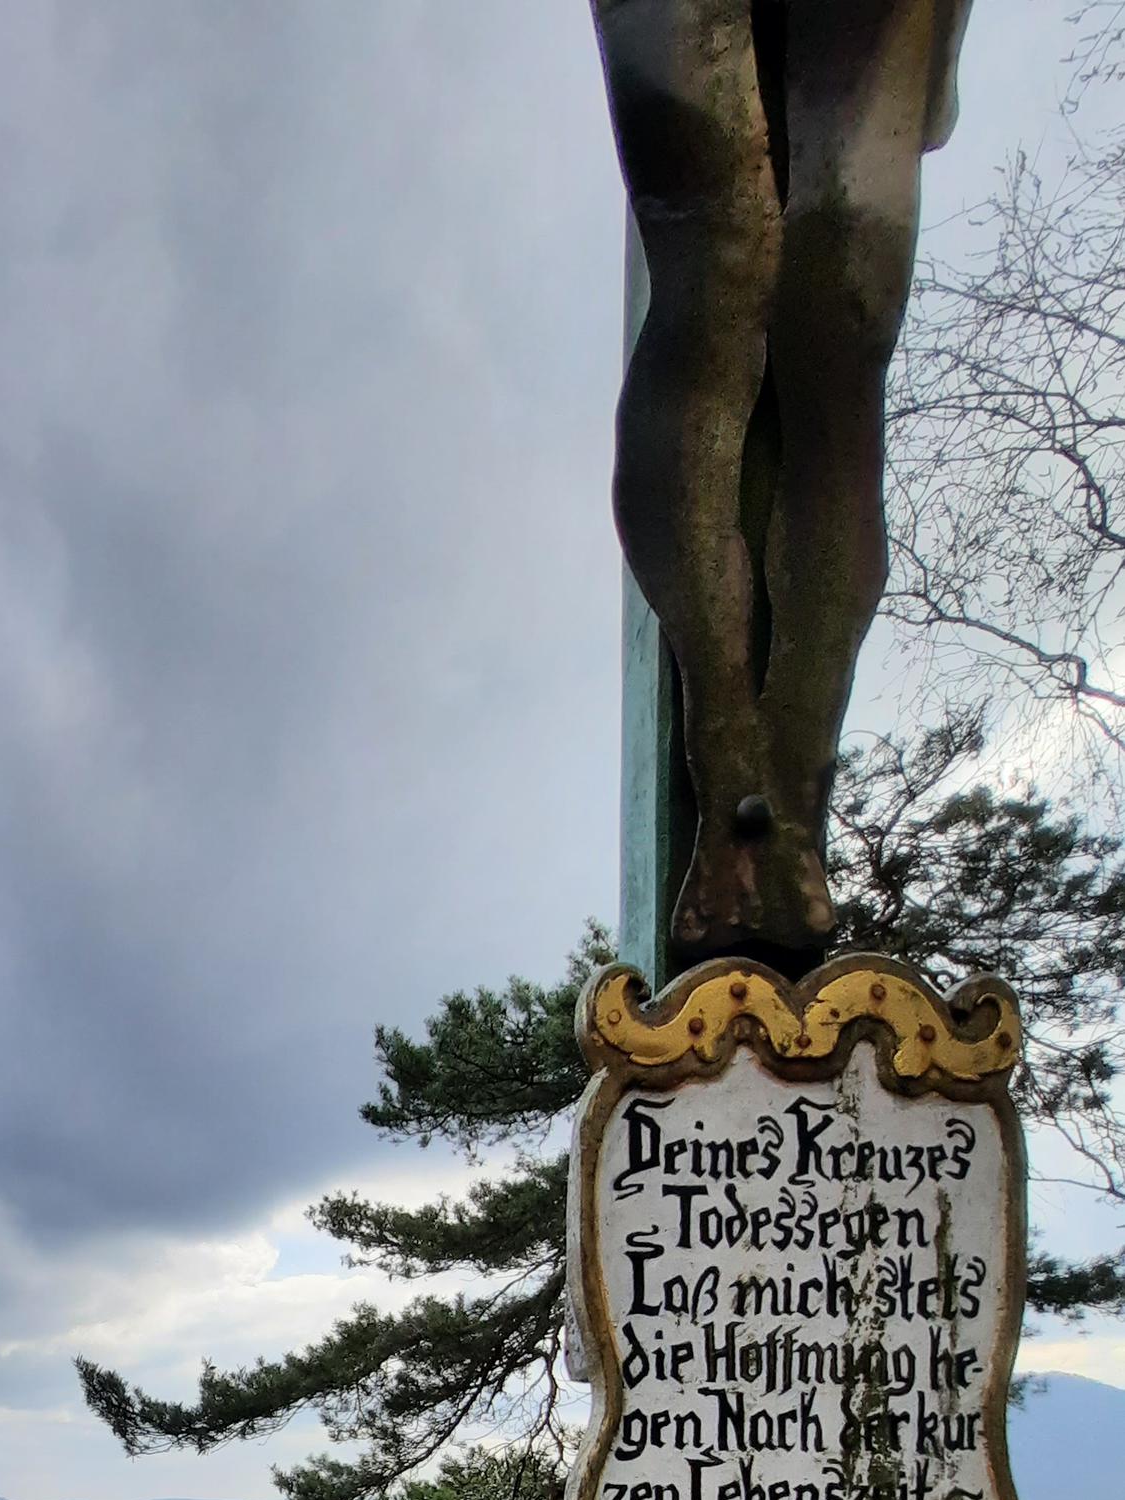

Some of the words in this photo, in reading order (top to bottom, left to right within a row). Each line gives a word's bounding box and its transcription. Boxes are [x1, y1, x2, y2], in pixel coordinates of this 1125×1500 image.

[613, 1096, 785, 1200] Deines
[785, 1096, 975, 1196] Kreuzes
[662, 1183, 930, 1259] Todessegen
[729, 1253, 856, 1319] mich
[875, 1253, 986, 1320] stets
[622, 1322, 694, 1390] die
[702, 1321, 917, 1396] Hoffnung
[614, 1408, 702, 1461] gen
[697, 1386, 826, 1453] Nach
